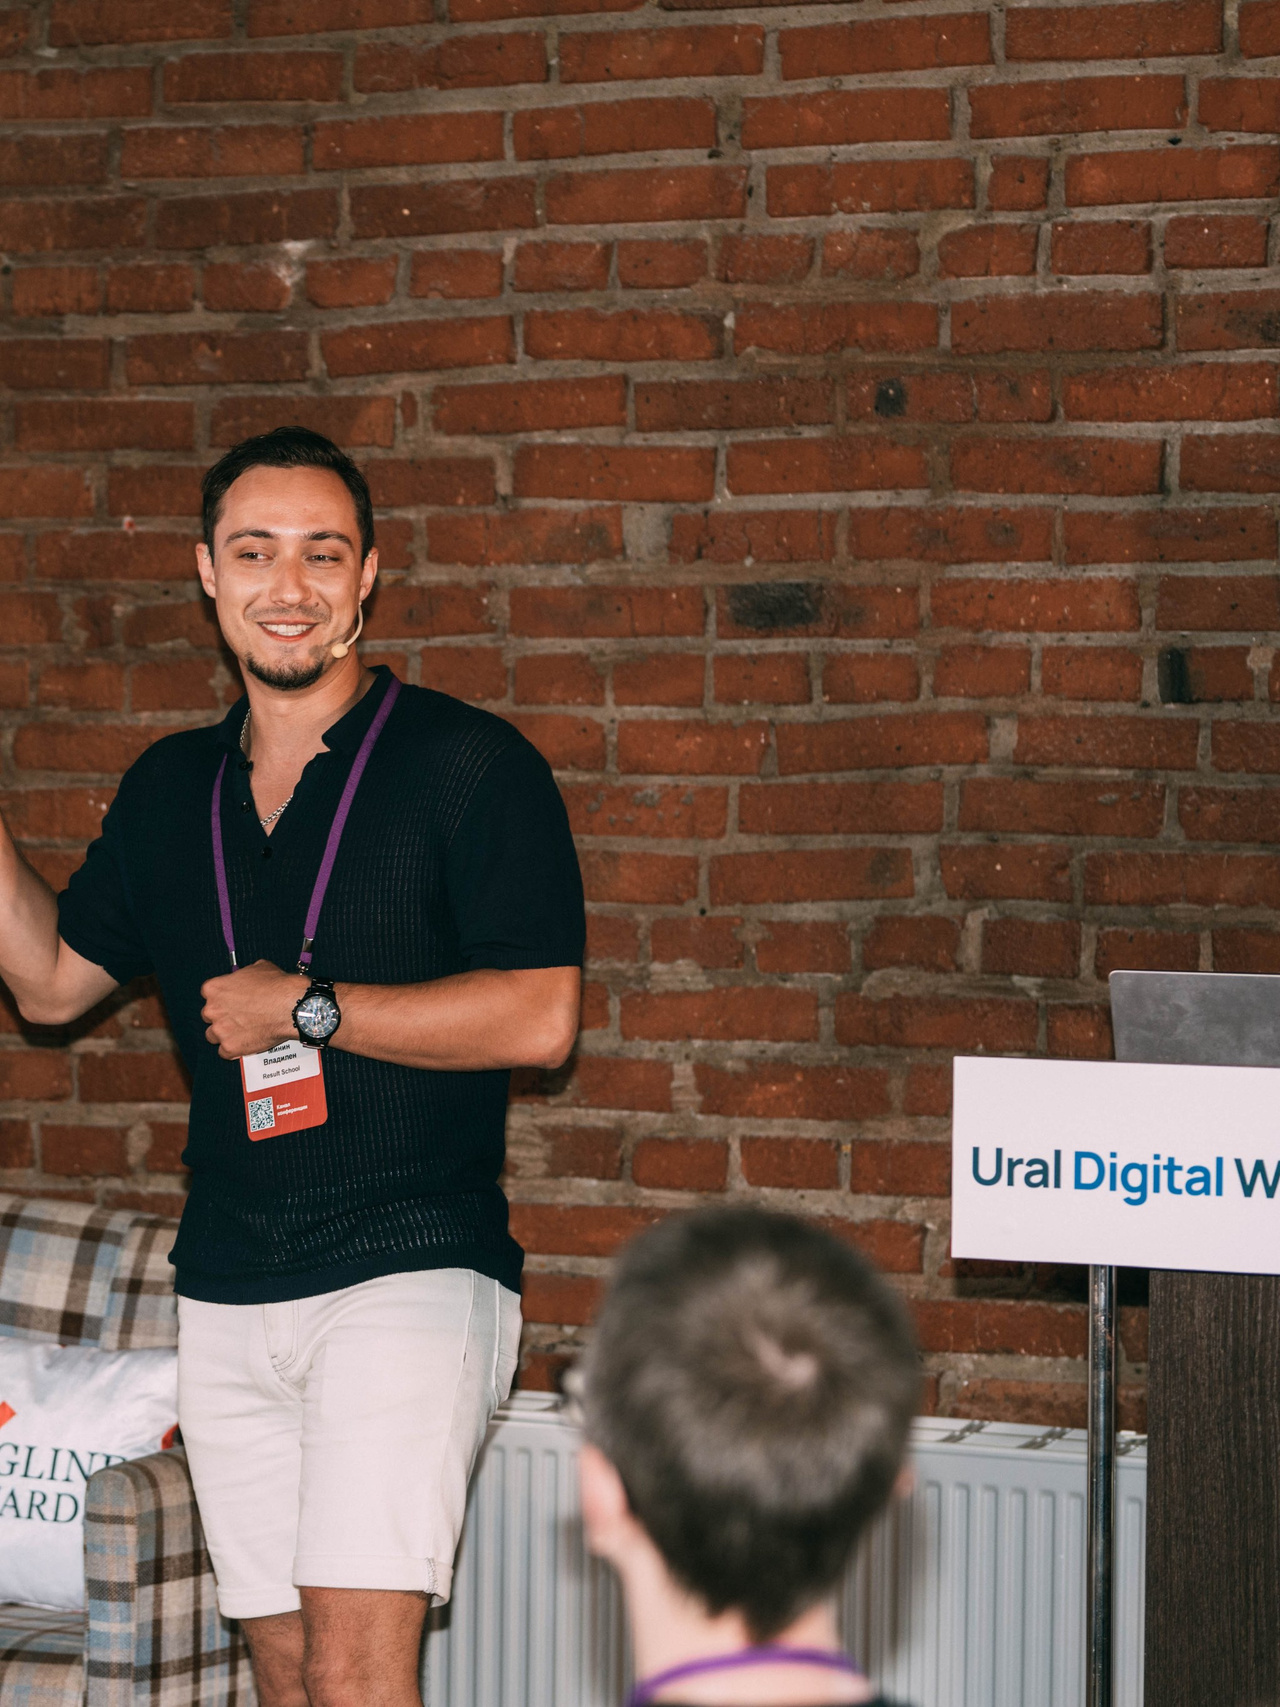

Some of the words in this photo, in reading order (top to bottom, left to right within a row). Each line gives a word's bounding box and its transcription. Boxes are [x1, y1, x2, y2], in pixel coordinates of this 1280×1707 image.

[263, 1053, 297, 1065] Владилен
[262, 1070, 280, 1079] Result
[281, 1065, 300, 1075] School
[972, 1146, 1062, 1189] Ural
[1073, 1150, 1224, 1206] Digital
